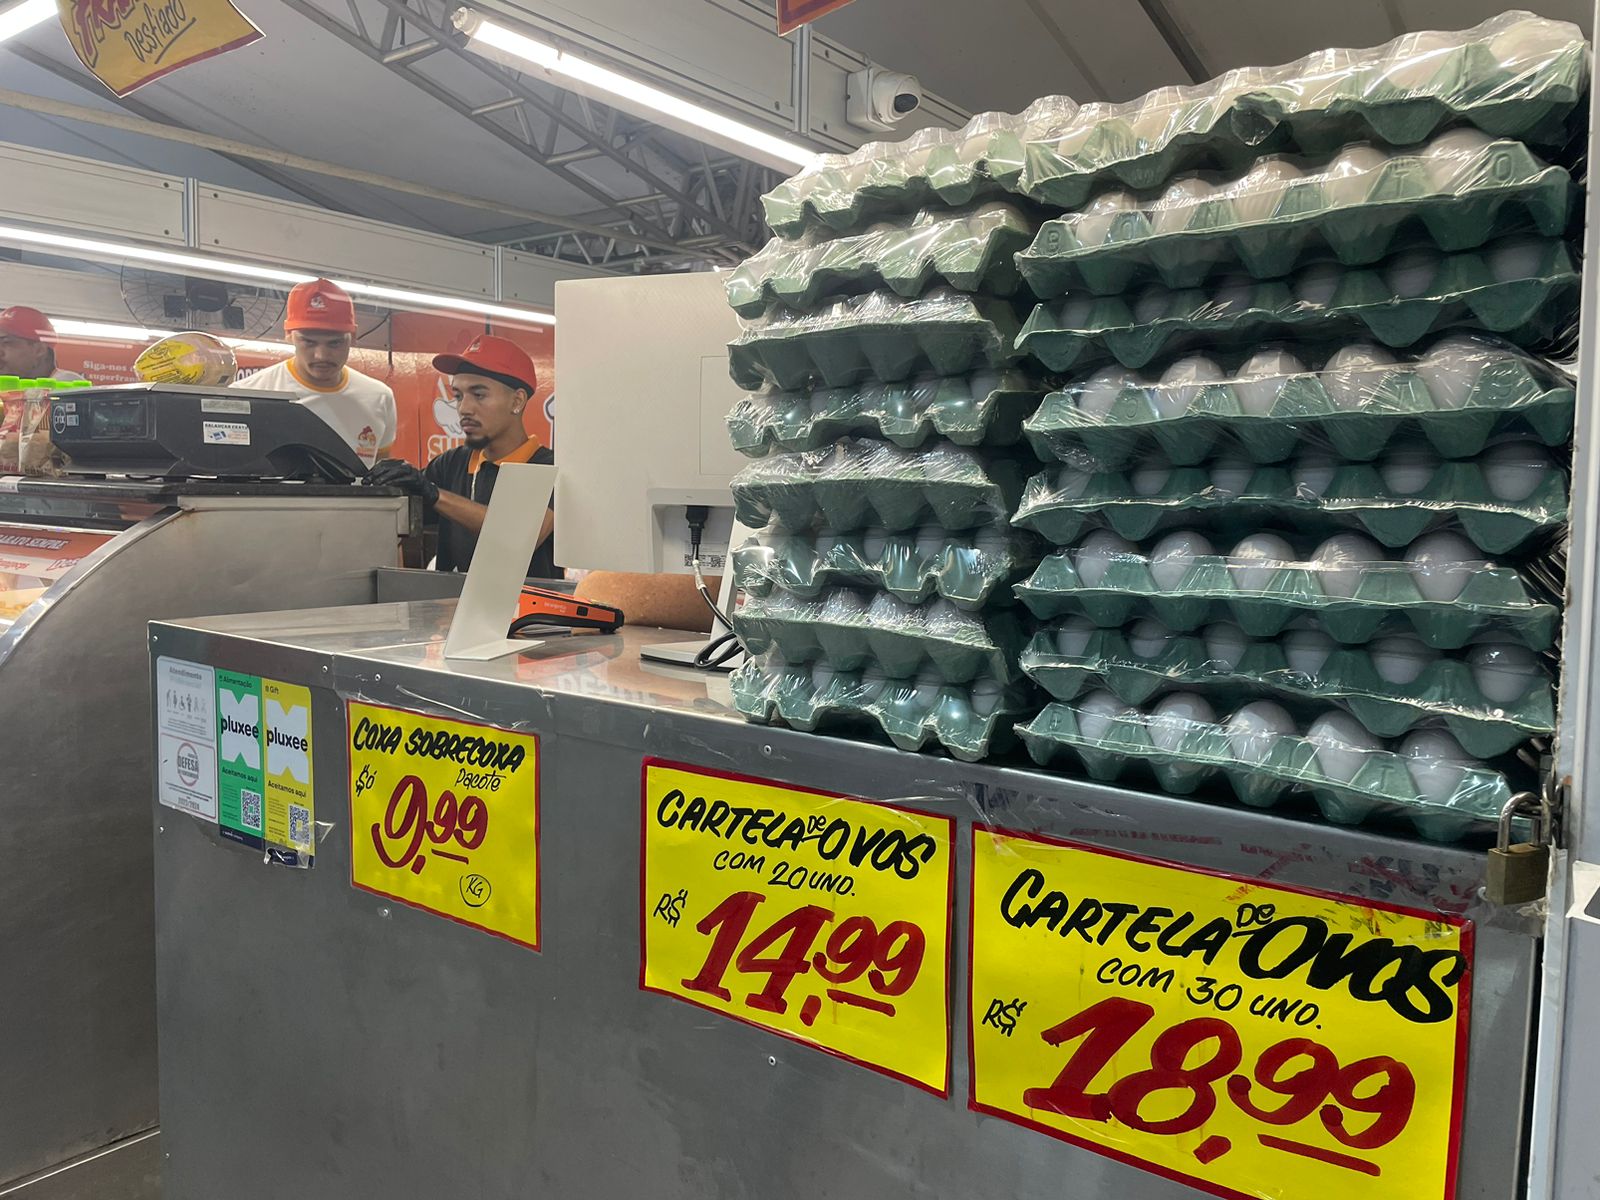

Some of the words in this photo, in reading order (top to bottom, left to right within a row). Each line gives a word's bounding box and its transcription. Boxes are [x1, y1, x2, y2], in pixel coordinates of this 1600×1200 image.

[83, 360, 127, 371] Siga-nos
[88, 373, 139, 383] superfran
[223, 675, 253, 689] Alimentação
[269, 685, 280, 695] Gift
[220, 715, 259, 739] pluxee
[266, 727, 308, 752] pluxee
[353, 717, 403, 755] COXA
[404, 727, 526, 773] SOBRECOXA
[177, 755, 199, 772] DEFESA
[222, 766, 247, 780] Aceitamos
[247, 774, 258, 783] aqui
[268, 780, 295, 795] Aceitamos
[295, 788, 307, 798] aqui
[657, 789, 806, 851] CARTELA
[817, 818, 936, 880] OVOS
[713, 850, 765, 873] COM
[768, 861, 808, 889] 20
[467, 877, 484, 899] KG
[653, 888, 688, 928] R$
[1000, 868, 1233, 965] CARTELA
[1238, 916, 1467, 1023] OVOS
[681, 891, 926, 1026] 14,99
[1096, 957, 1175, 993] COM
[1186, 976, 1243, 1012] 30
[981, 997, 1026, 1037] R$
[1023, 996, 1416, 1164] 18,99
